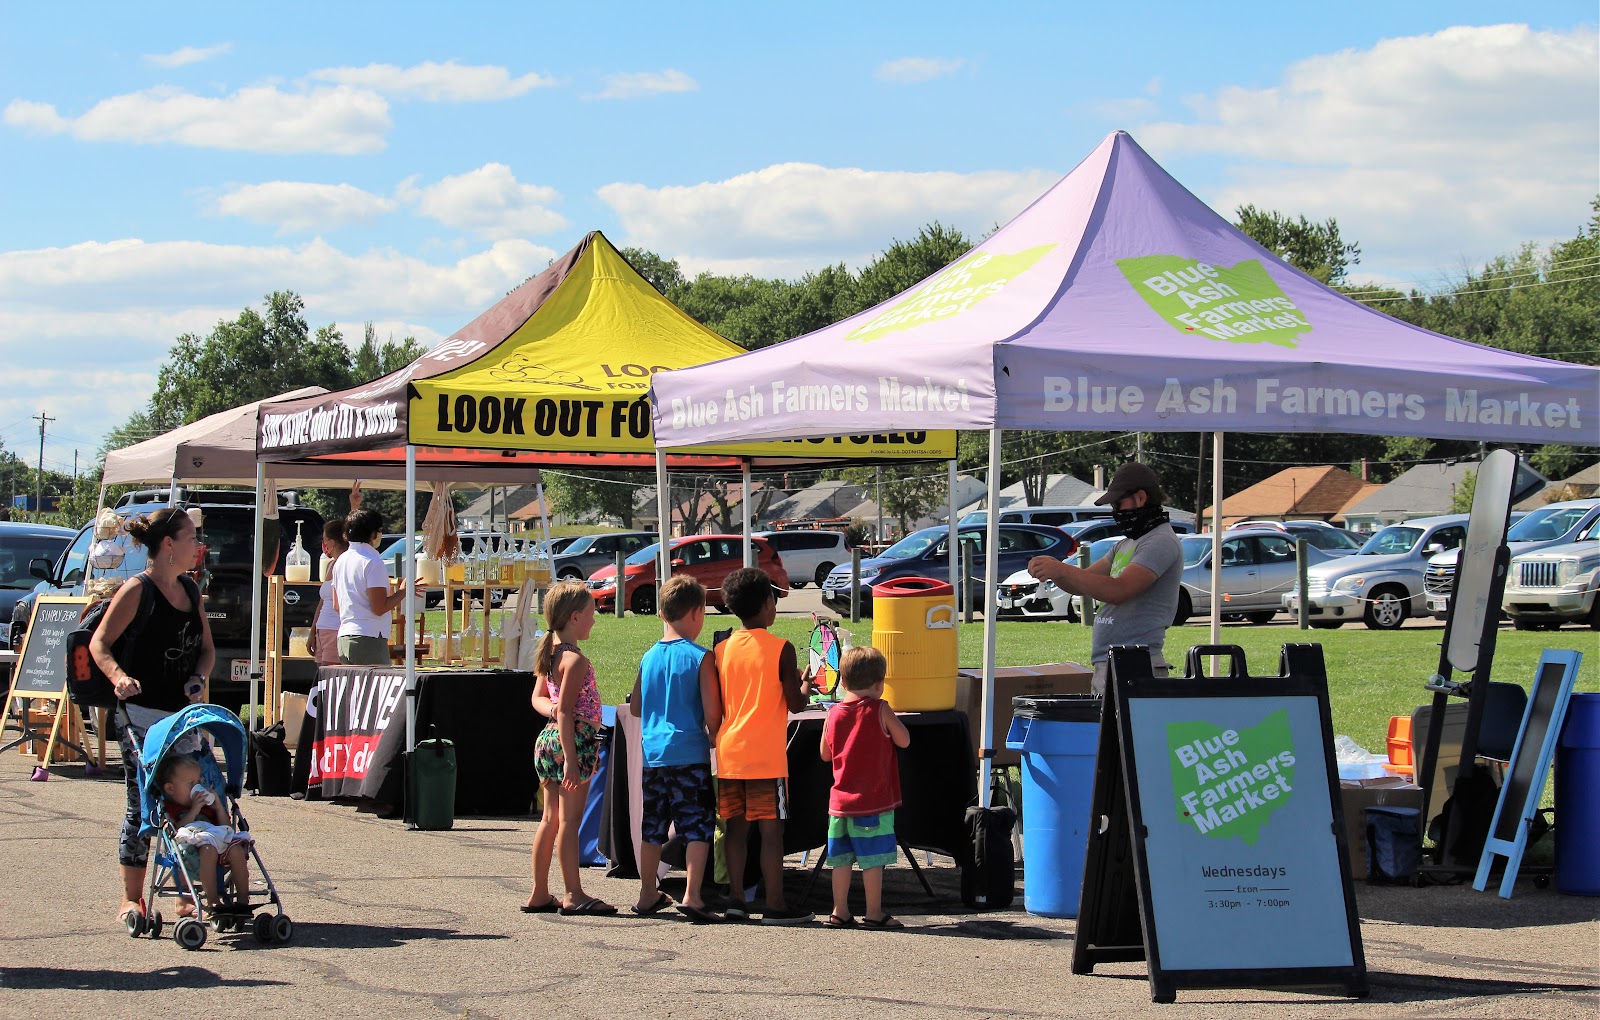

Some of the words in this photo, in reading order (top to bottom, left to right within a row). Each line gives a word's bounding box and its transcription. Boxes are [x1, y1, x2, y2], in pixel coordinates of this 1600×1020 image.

[1142, 262, 1220, 297] Blue
[1176, 279, 1240, 310] Ash
[1174, 296, 1297, 330] Farmers
[1199, 310, 1310, 340] Market
[607, 382, 649, 390] FOR
[671, 395, 719, 430] Blue
[723, 386, 764, 423] Ash
[771, 380, 869, 415] Farmers
[879, 376, 971, 412] Market
[1043, 376, 1145, 414] Blue
[1155, 377, 1237, 414] Ash
[1256, 378, 1426, 421] Farmers
[1445, 387, 1582, 429] Market
[437, 393, 527, 435] LOOK
[534, 398, 604, 438] OUT
[611, 401, 651, 439] FO
[40, 610, 62, 622] SIMPLY
[61, 610, 77, 622] ZERO
[1175, 729, 1240, 769] Blue
[1181, 751, 1296, 815] Farmers
[1195, 748, 1248, 786] Ash
[1192, 774, 1293, 834] Market
[1202, 865, 1286, 880] Wednesdays
[1236, 885, 1258, 893] from
[1208, 900, 1241, 909] 3:30pm
[1257, 899, 1290, 908] 7:00pm
